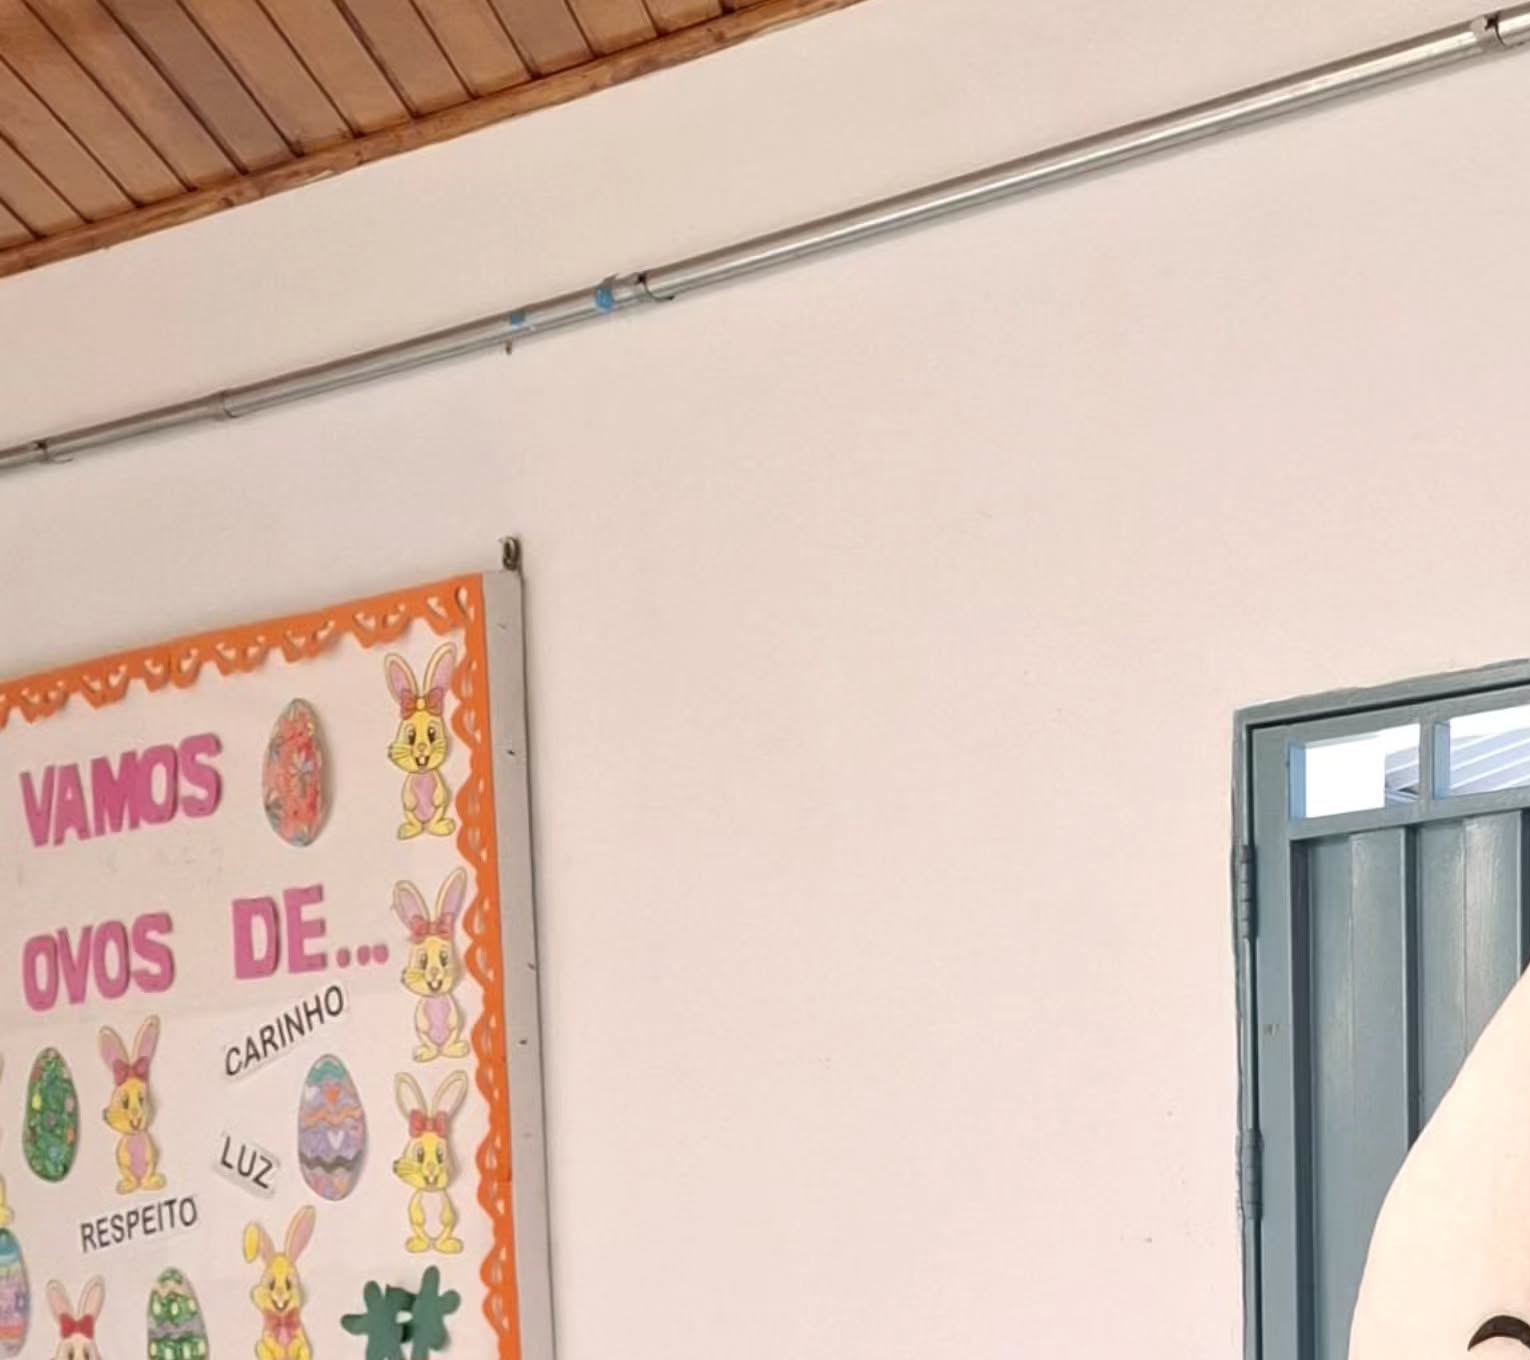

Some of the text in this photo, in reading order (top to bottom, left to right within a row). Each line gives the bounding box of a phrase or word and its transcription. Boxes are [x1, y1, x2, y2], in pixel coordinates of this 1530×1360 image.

[19, 733, 223, 847] VAMOS
[22, 884, 389, 1012] OVOS DE...
[224, 985, 345, 1077] CARINHO
[219, 1136, 276, 1189] LUZ
[81, 1197, 198, 1252] RESPEITO
